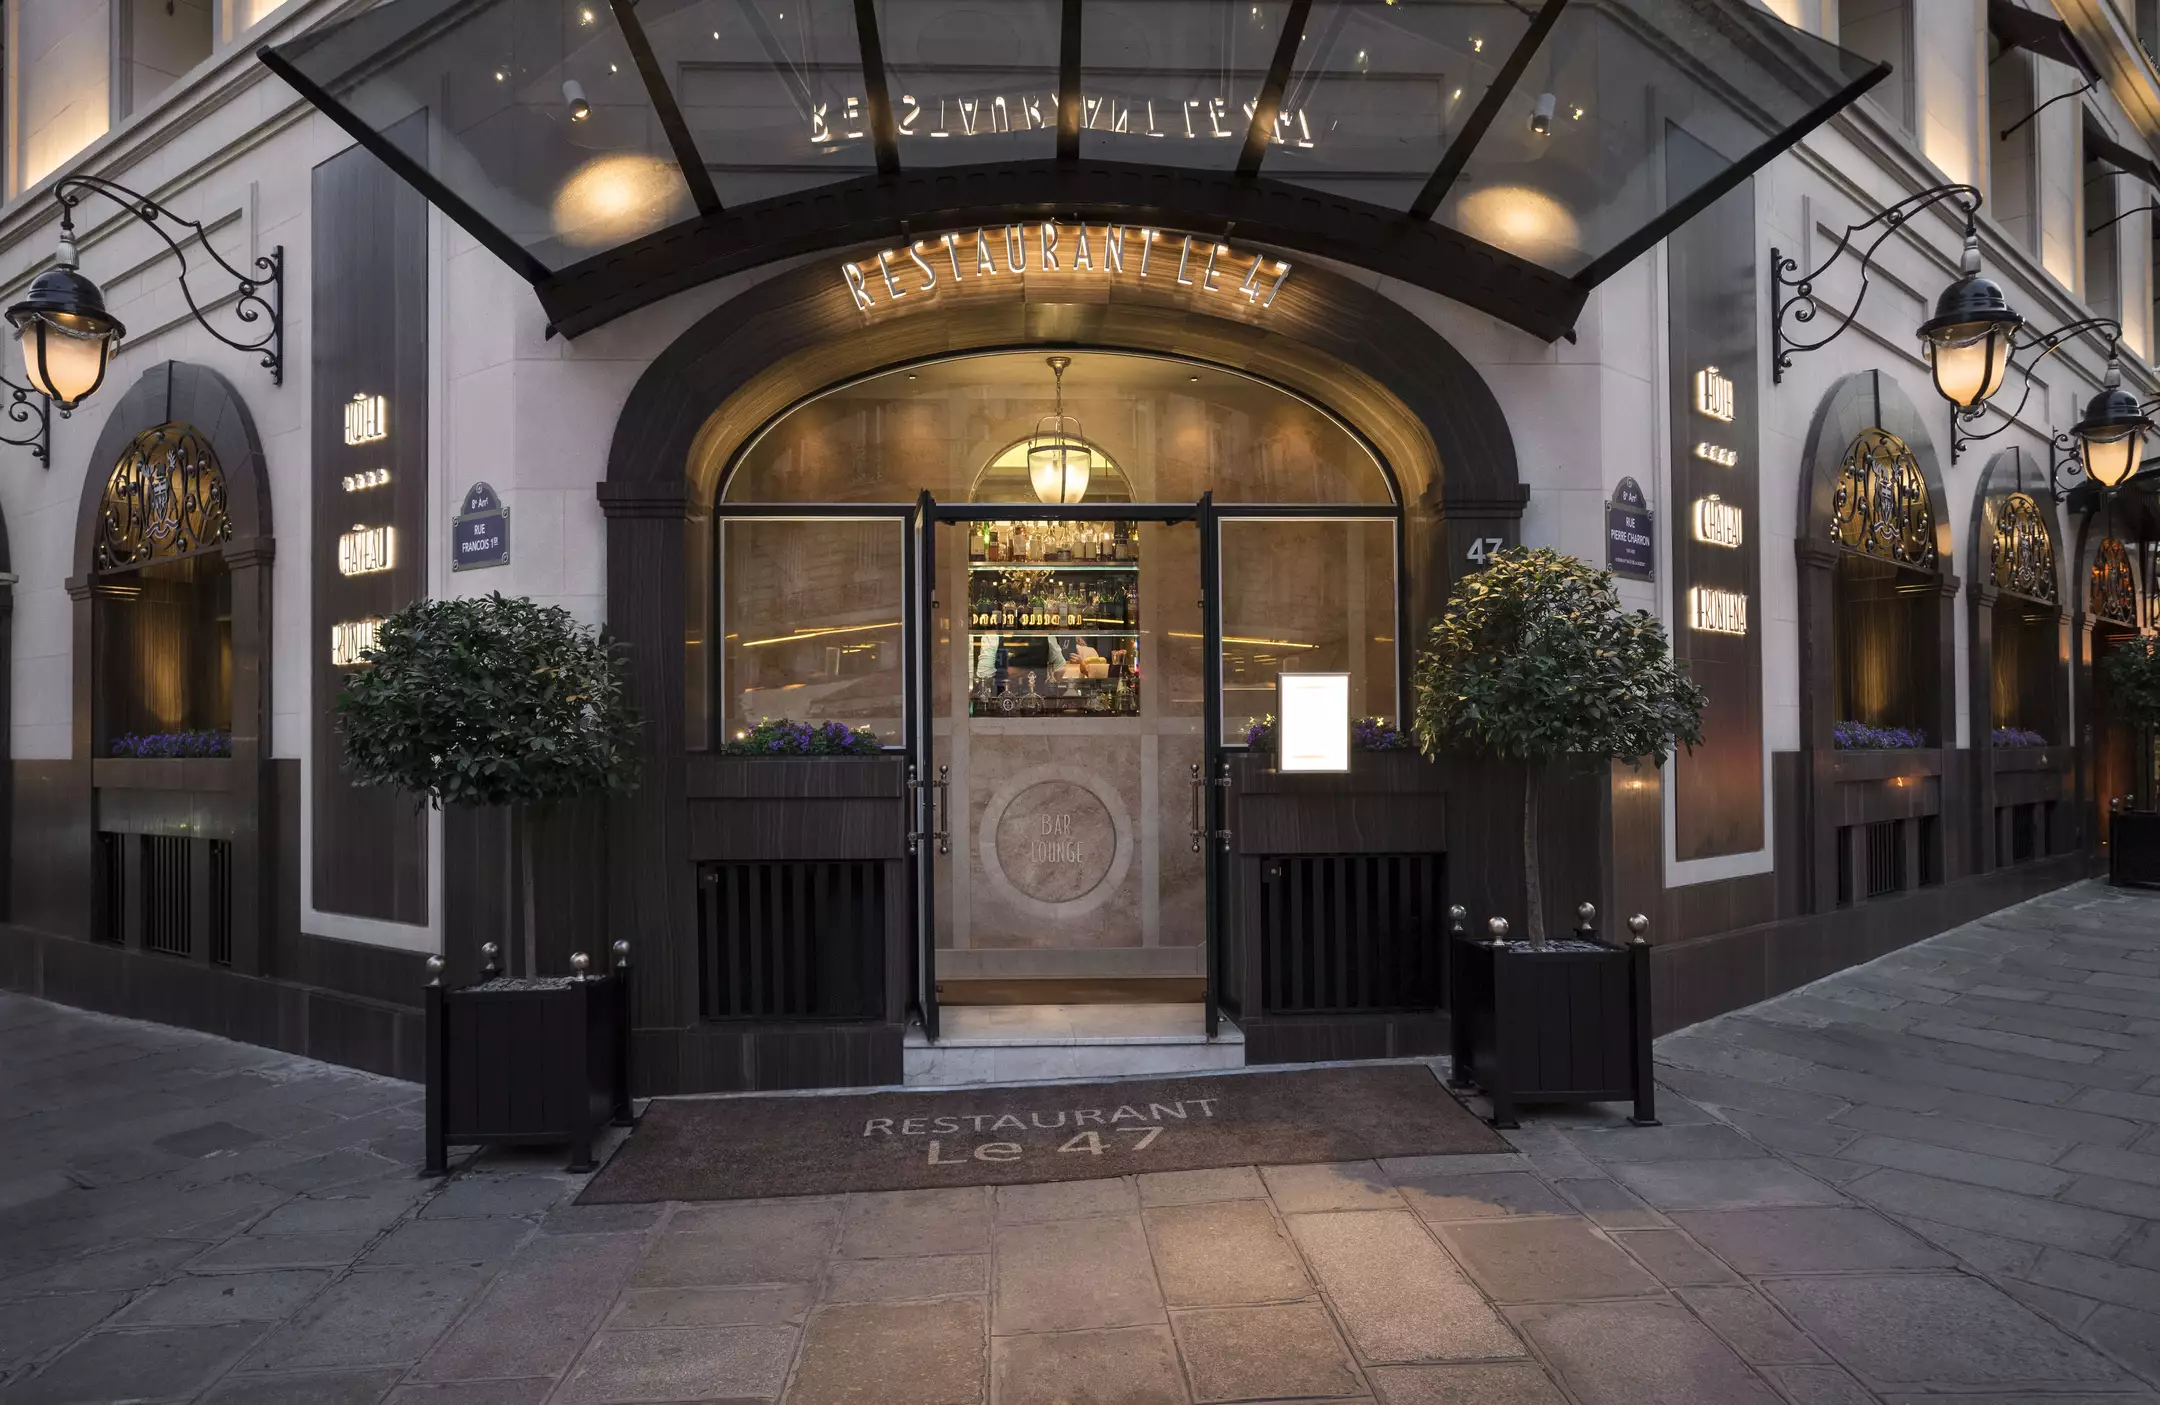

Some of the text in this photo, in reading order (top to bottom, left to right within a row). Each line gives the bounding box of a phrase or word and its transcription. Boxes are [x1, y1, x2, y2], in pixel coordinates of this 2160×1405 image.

[842, 222, 1292, 310] RESTAURANT LE 47
[474, 524, 485, 535] RUE
[1626, 517, 1635, 528] RUE
[1610, 529, 1650, 546] PIERRE CHARRON
[1466, 537, 1503, 565] 47
[1041, 814, 1071, 835] BAR
[1031, 841, 1083, 863] LOUNGE
[863, 1099, 1218, 1137] RESTAURANT
[1058, 1126, 1164, 1156] 47
